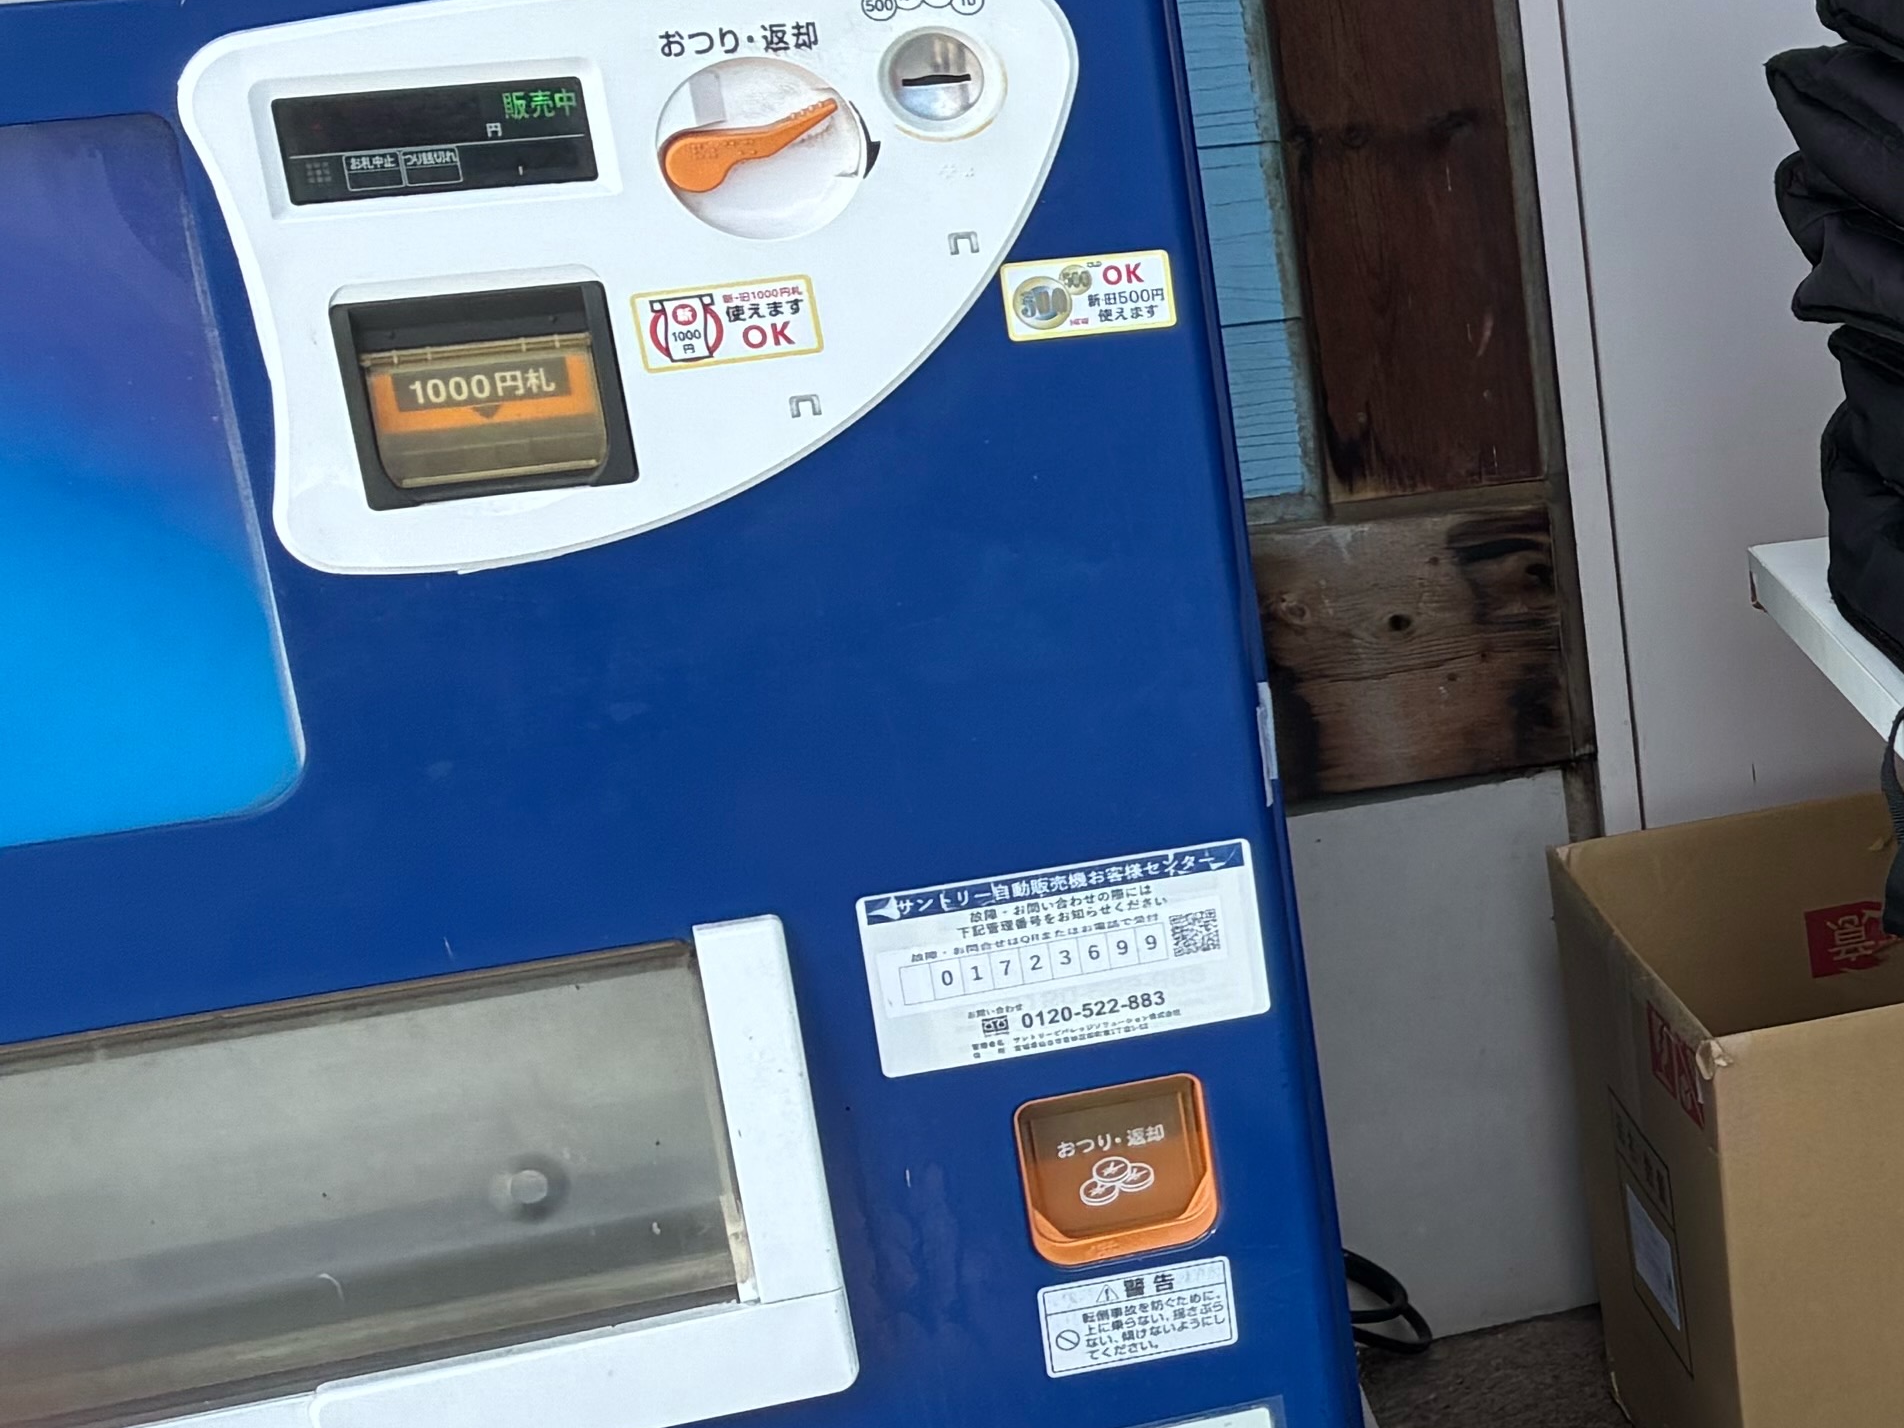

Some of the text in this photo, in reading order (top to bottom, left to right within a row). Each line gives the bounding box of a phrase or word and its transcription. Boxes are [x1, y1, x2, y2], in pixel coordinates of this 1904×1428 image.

[659, 22, 819, 57] おつり・返却
[502, 88, 577, 120] 販売中
[1102, 262, 1144, 285] OK
[725, 298, 804, 322] 使えます
[1098, 304, 1158, 322] 使えます
[672, 329, 701, 342] 1000
[742, 320, 795, 349] OK
[683, 343, 695, 354] 円
[409, 368, 556, 405] 1000円札
[1022, 991, 1165, 1028] 0120-522-883
[1057, 1124, 1165, 1160] おつり・返却
[1124, 1273, 1175, 1298] 警告
[1088, 1341, 1159, 1360] てください。
